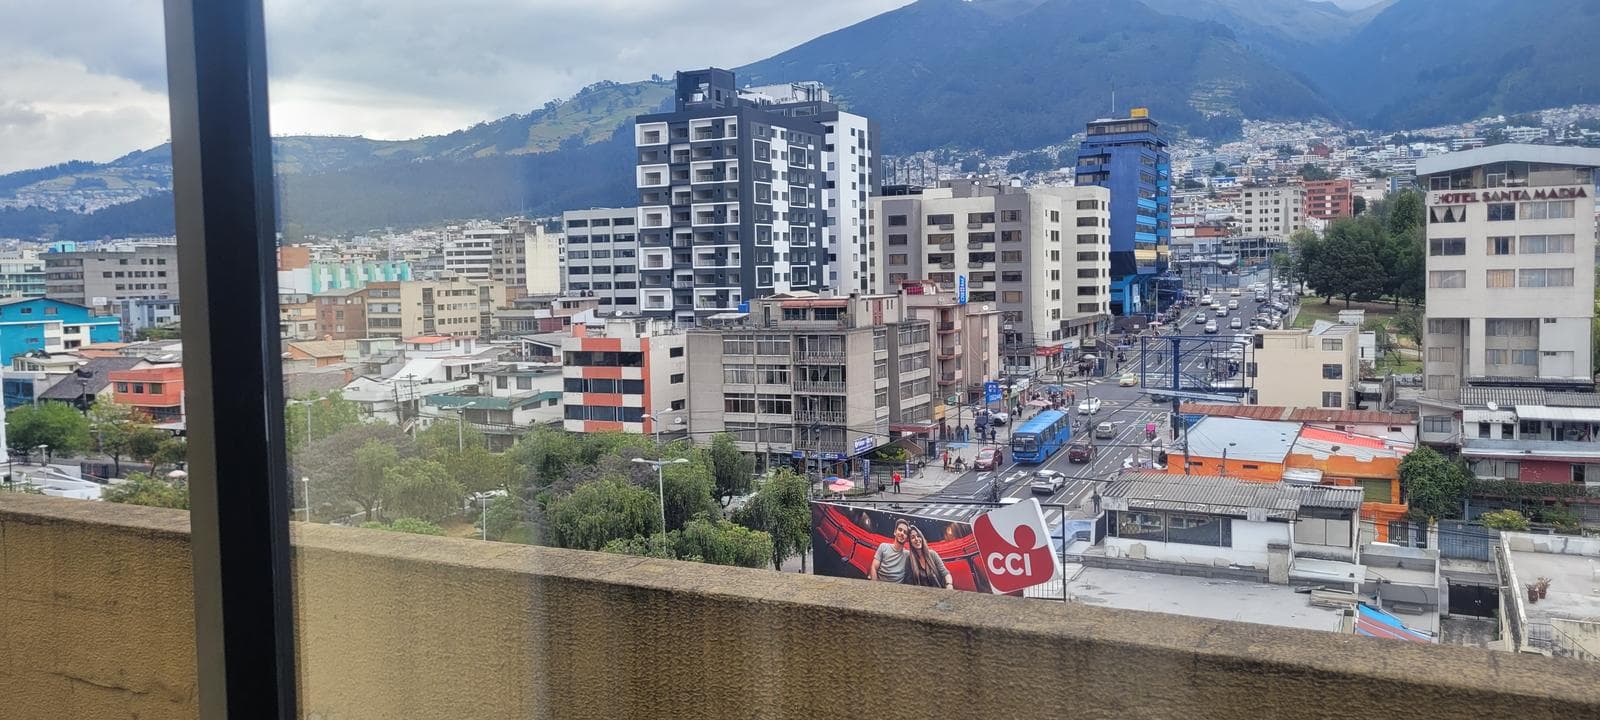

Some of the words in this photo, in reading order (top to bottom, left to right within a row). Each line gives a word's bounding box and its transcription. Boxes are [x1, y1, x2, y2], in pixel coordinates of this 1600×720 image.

[1439, 192, 1479, 204] HOTEL
[1482, 189, 1531, 203] SANTA
[1532, 186, 1588, 200] MARIA
[987, 552, 1032, 576] CCI
